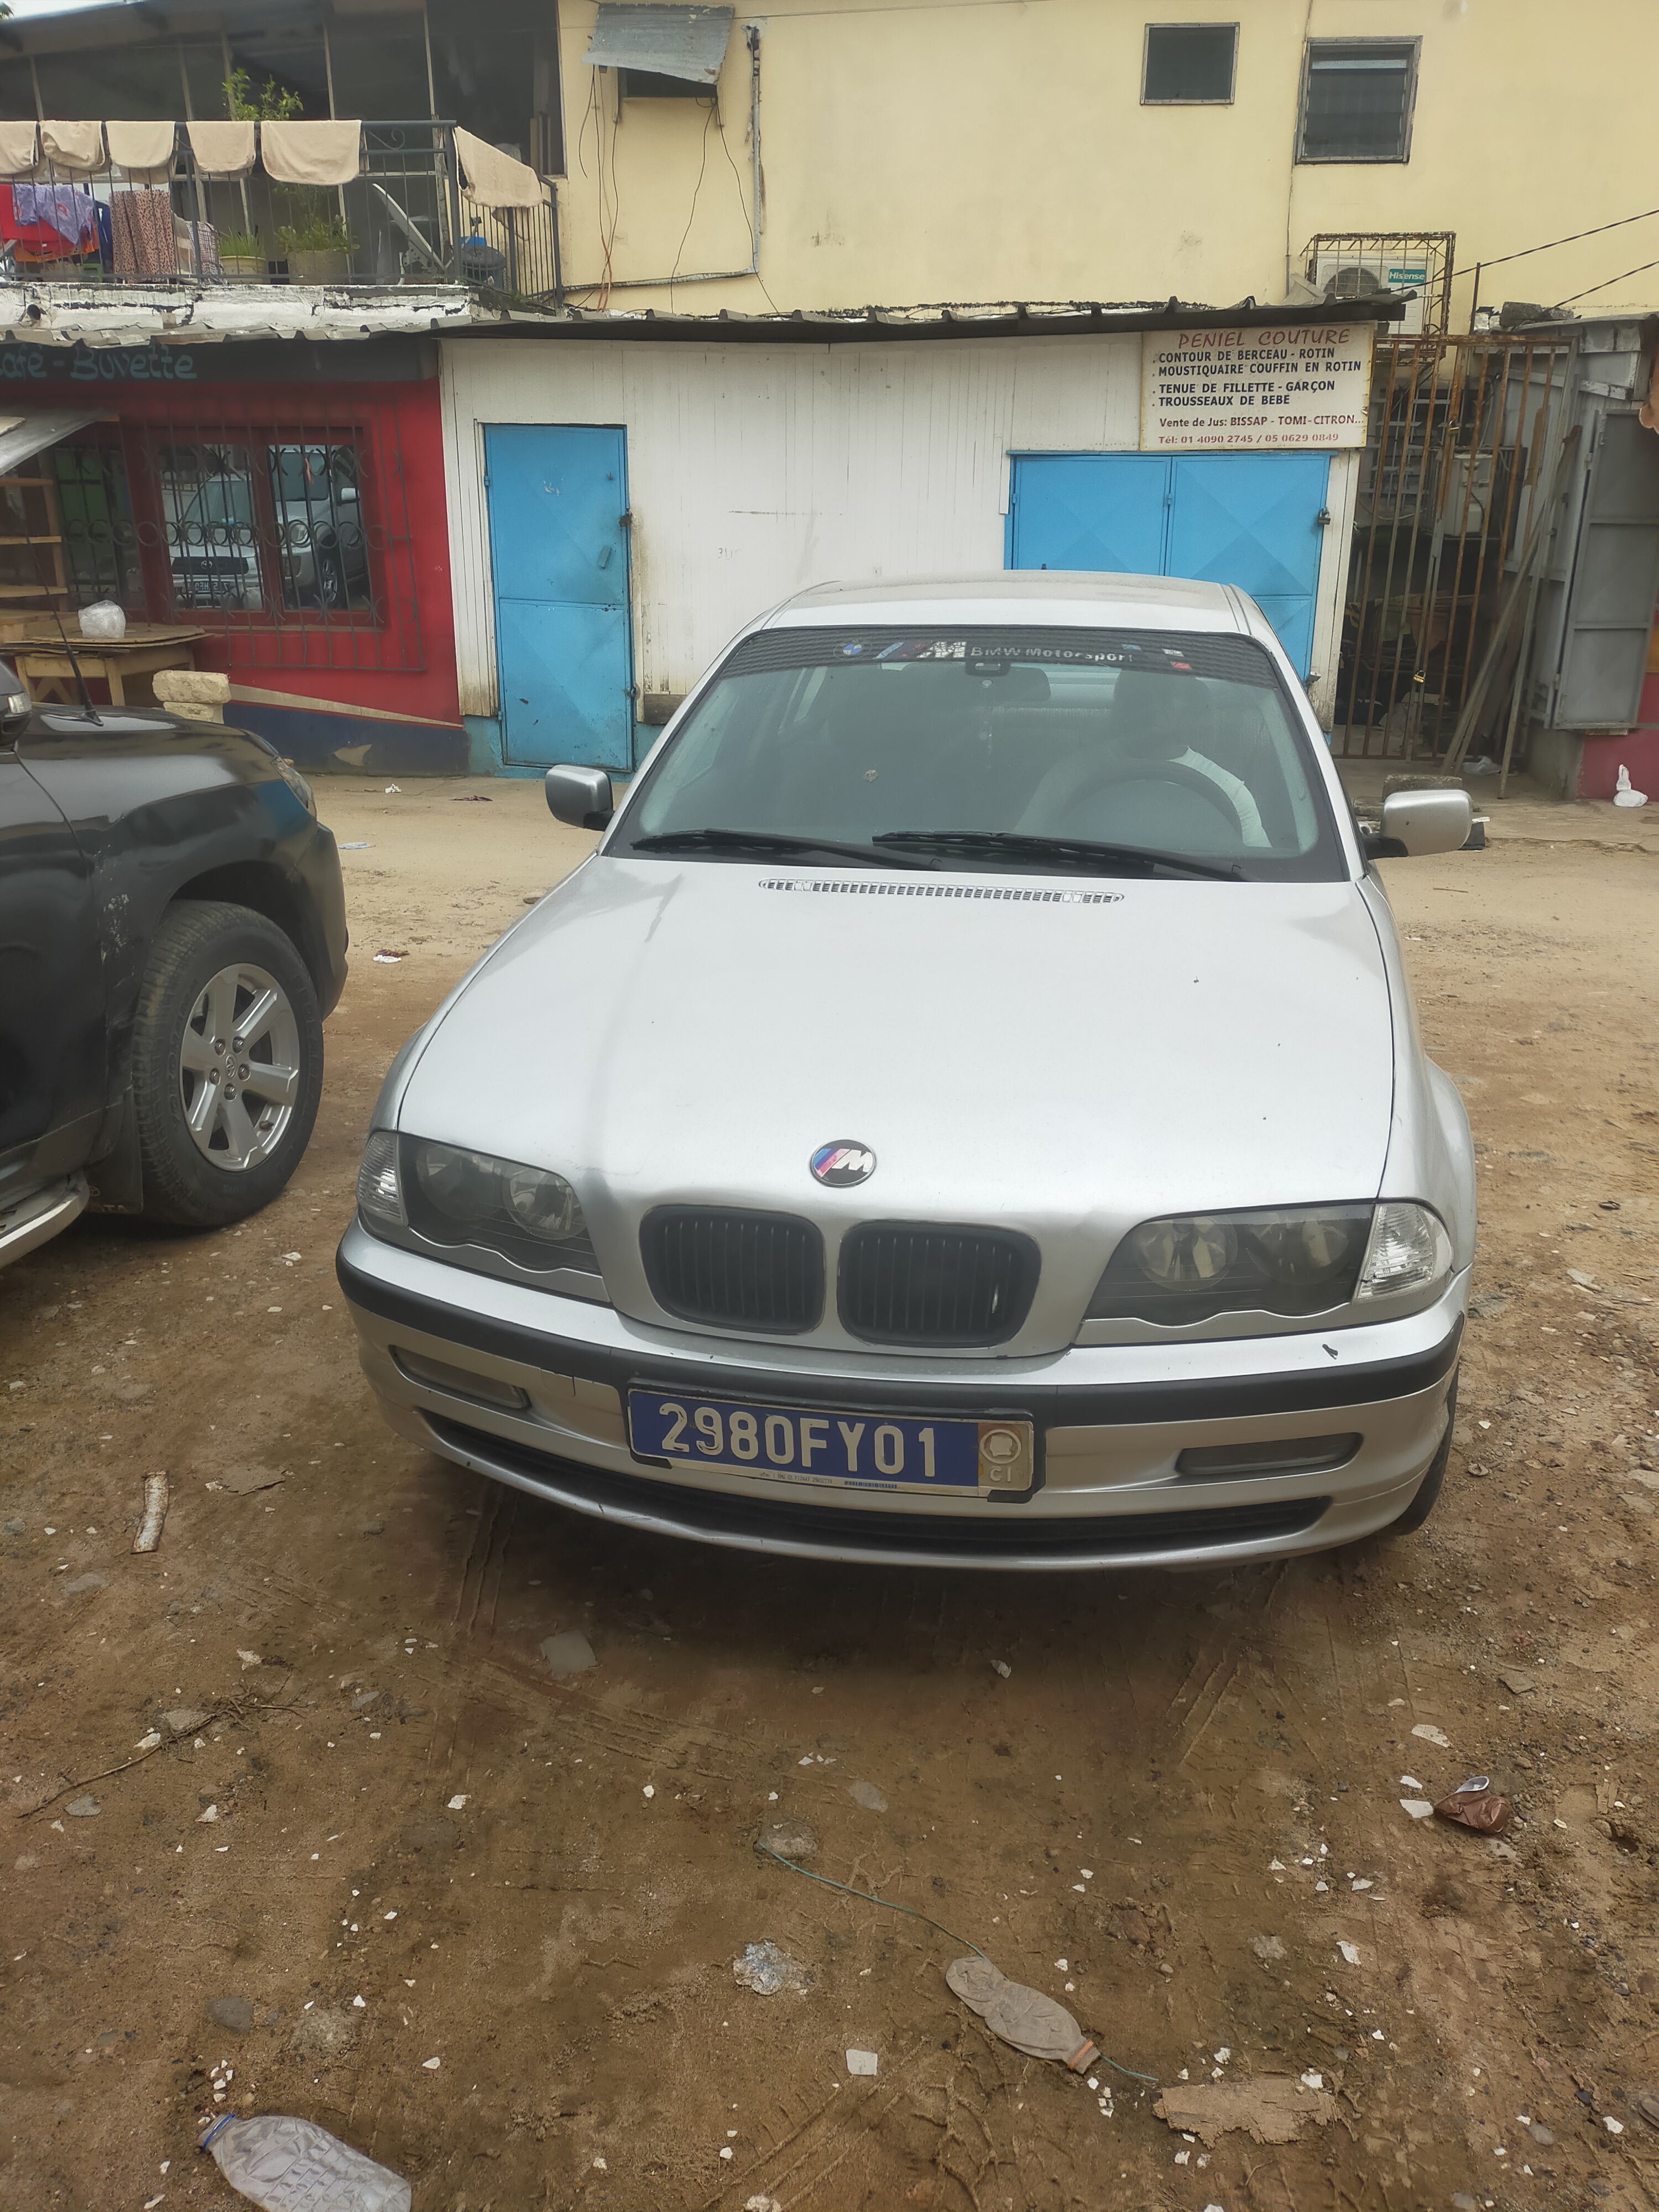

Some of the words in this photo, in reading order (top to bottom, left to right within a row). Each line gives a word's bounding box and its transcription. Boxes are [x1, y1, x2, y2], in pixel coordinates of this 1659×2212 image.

[1389, 272, 1425, 280] Hisense
[1178, 331, 1244, 349] PENIEL
[1258, 328, 1350, 346] COUTURE
[0, 343, 48, 381] afé
[70, 344, 197, 380] Buvette
[1159, 352, 1212, 363] CONTOUR
[1217, 350, 1232, 361] DE
[1238, 348, 1287, 360] BERCEAU
[1300, 347, 1335, 359] ROTIN
[1159, 364, 1244, 377] MOUSTIQUAIRE
[1250, 362, 1298, 373] COUFFIN
[1305, 362, 1319, 372] EN
[1326, 361, 1361, 372] ROTIN
[1160, 383, 1196, 394] TENUE
[1202, 383, 1217, 393] DE
[1223, 382, 1275, 393] FILLETTE
[1286, 380, 1335, 393] GARÇON
[1159, 396, 1234, 406] TROUSSEAUX
[1240, 396, 1255, 405] DE
[1261, 394, 1290, 405] BEBE
[1160, 418, 1190, 427] Vente
[1192, 418, 1205, 426] de
[1208, 418, 1227, 426] Jus:
[1230, 416, 1267, 426] BISSAP
[970, 646, 1020, 657] BMW
[1025, 647, 1134, 662] Motorsport
[659, 1402, 935, 1477] 2980FY01
[990, 1465, 1011, 1482] CI
